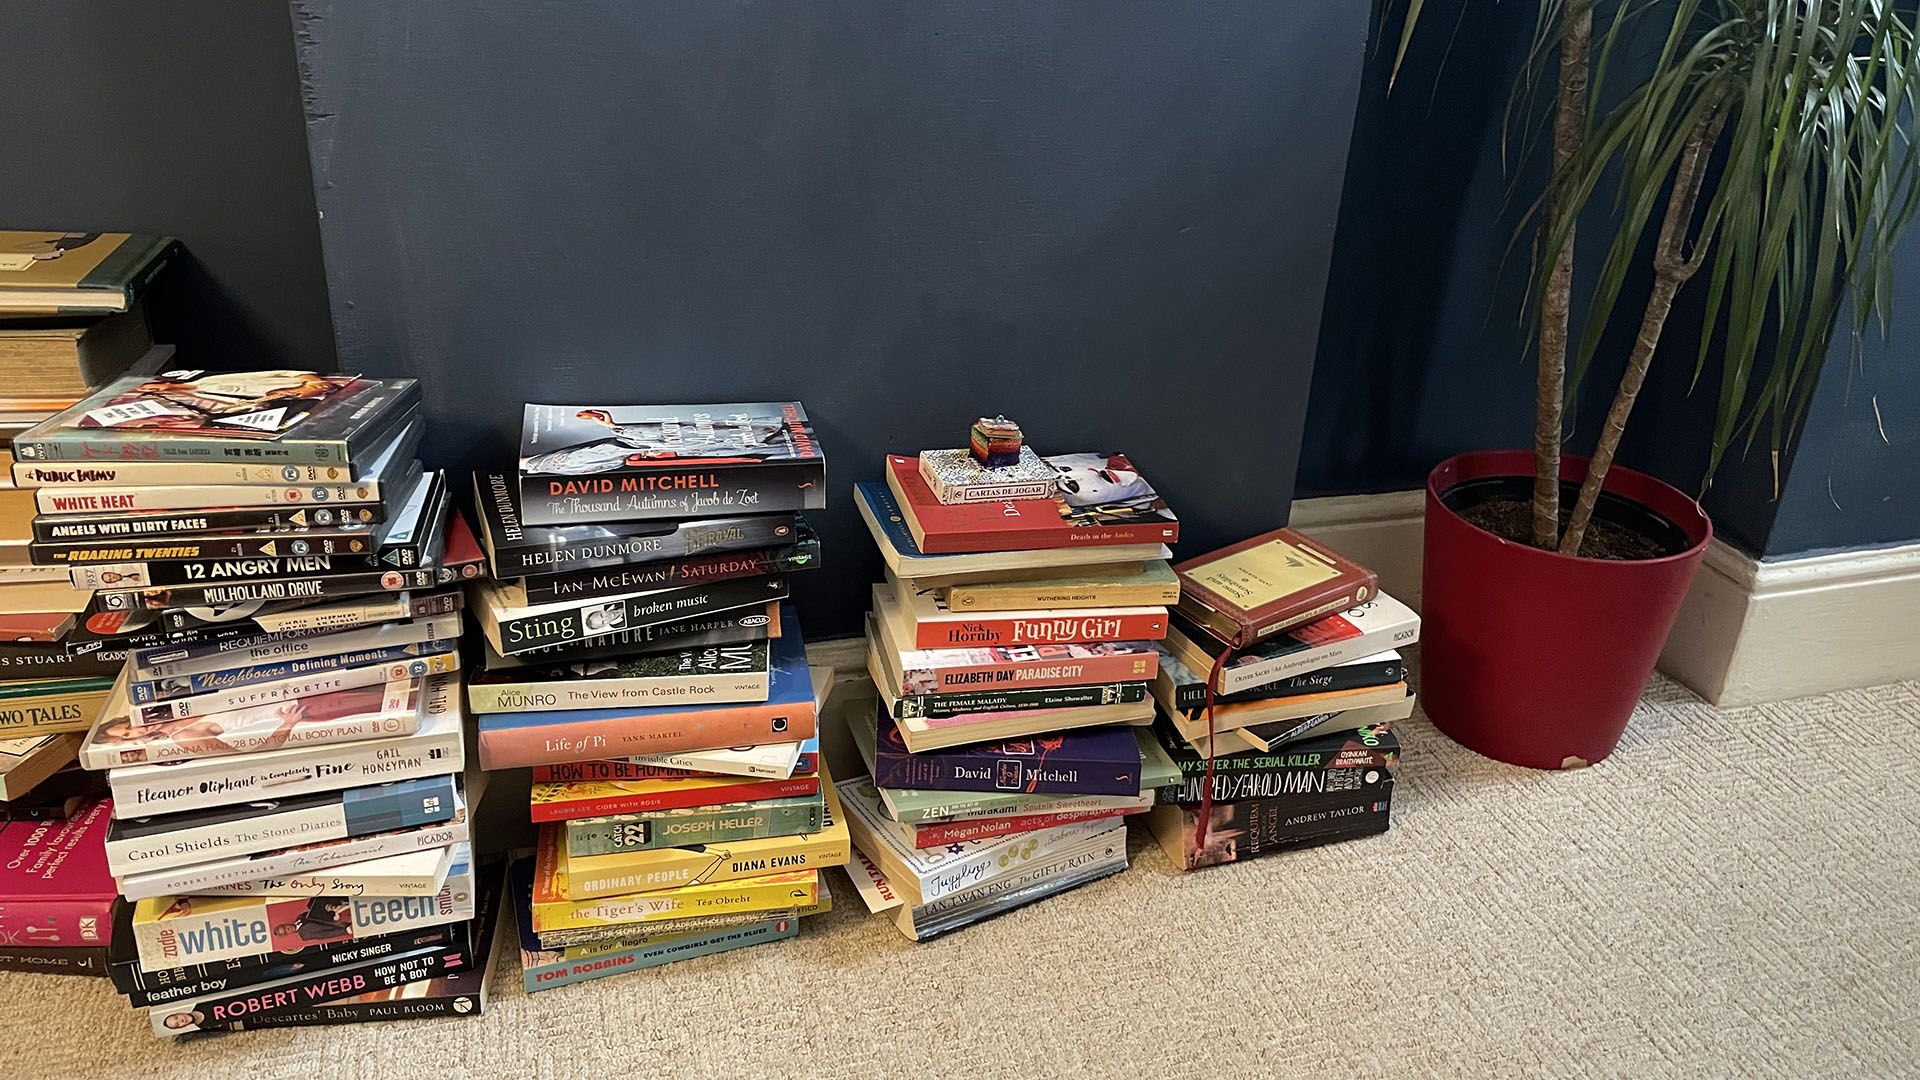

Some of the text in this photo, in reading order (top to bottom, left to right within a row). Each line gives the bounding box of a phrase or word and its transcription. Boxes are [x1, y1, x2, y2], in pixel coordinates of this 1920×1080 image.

[36, 468, 116, 482] PUBLIC ENEMY
[550, 474, 719, 496] DAVID MITCHELL
[547, 489, 759, 515] The Thousand Autumns of Jacob de Zoet
[969, 486, 1042, 497] CARTAS DE JOGAR
[52, 518, 207, 537] ANGELS WITH DIRTY FACES
[68, 546, 200, 561] ROARING TWENTIES
[522, 539, 662, 566] HELEN DUNMORE
[184, 556, 331, 579] 12 ANGRY MEN
[554, 580, 583, 595] IAN
[681, 559, 758, 579] SATURDAY
[204, 581, 324, 603] MULHOLLAND DRIVE
[508, 593, 709, 643] Sting broken music
[659, 625, 687, 636] JANE
[691, 620, 734, 632] HARPER
[962, 623, 985, 632] Nick
[949, 618, 1122, 644] Hornby Funny Girl
[16, 654, 73, 666] STUART
[250, 646, 270, 657] the
[274, 642, 309, 654] office
[197, 649, 388, 688] Neighbours Defining Moments
[945, 665, 1084, 685] ELIZABETH DAY PARADISE CITY
[228, 680, 342, 705] SUFFRAGETTE
[1290, 676, 1333, 688] The Siege
[498, 694, 556, 708] MUNRO
[568, 691, 589, 700] The
[591, 689, 618, 699] View
[622, 688, 649, 698] from
[652, 687, 686, 696] Castle
[690, 685, 715, 694] Rock
[27, 704, 82, 726] TALES
[156, 745, 204, 758] JOANNA
[233, 740, 246, 749] 28
[249, 737, 270, 747] DAY
[272, 733, 302, 744] TOTAL
[305, 729, 333, 740] BODY
[337, 726, 363, 736] PLAN
[546, 732, 684, 753] Life of Pi YANN MARTEL
[377, 750, 401, 760] GAIL
[1253, 753, 1321, 769] SERIAL KILLER
[138, 787, 194, 804] Eleanor
[200, 775, 258, 795] Oliphant
[269, 766, 311, 779] Completely
[316, 762, 356, 779] Fine
[363, 759, 422, 775] HONEYMAN
[550, 764, 583, 781] HOW
[587, 763, 609, 779] TO
[614, 764, 632, 778] BE
[954, 767, 991, 780] David
[1026, 769, 1077, 782] Mitchell
[1283, 771, 1325, 793] MAN
[663, 817, 764, 836] JOSEPH HELLER
[1285, 806, 1365, 826] ANDREW TAYLOR
[128, 818, 342, 861] Carol Shields The Stone Diaries
[944, 822, 1011, 839] Megan Nolan
[167, 877, 208, 889] ROBERT
[417, 831, 454, 846] PICADOR
[584, 875, 642, 892] ORDINARY
[647, 869, 689, 883] PEOPLE
[733, 859, 766, 873] DIANA
[771, 854, 806, 868] EVANS
[924, 901, 951, 916] TAN
[989, 880, 1011, 894] ENG
[1032, 864, 1058, 880] GIFT
[1069, 852, 1096, 868] RAIN
[260, 880, 286, 890] The
[290, 877, 325, 896] Only
[332, 878, 364, 896] Story
[571, 895, 751, 920] the Tiger's Wife Téa Obreht
[160, 929, 179, 959] zadie
[179, 919, 268, 955] white
[353, 896, 436, 928] teeth
[332, 944, 393, 964] NICKY SINGER
[536, 968, 569, 983] TOM
[573, 954, 635, 975] ROBBINS
[643, 950, 664, 959] EVEN
[667, 940, 708, 954] COWGIRLS
[710, 936, 725, 944] GET
[744, 928, 768, 937] BLUES
[384, 968, 429, 986] BE A BOY
[147, 979, 228, 1002] feather boy
[213, 957, 435, 1021] ROBERT WEBB HOW NOT TO
[327, 1009, 360, 1020] Baby
[369, 1007, 399, 1016] PAUL
[404, 1004, 445, 1013] BLOOM
